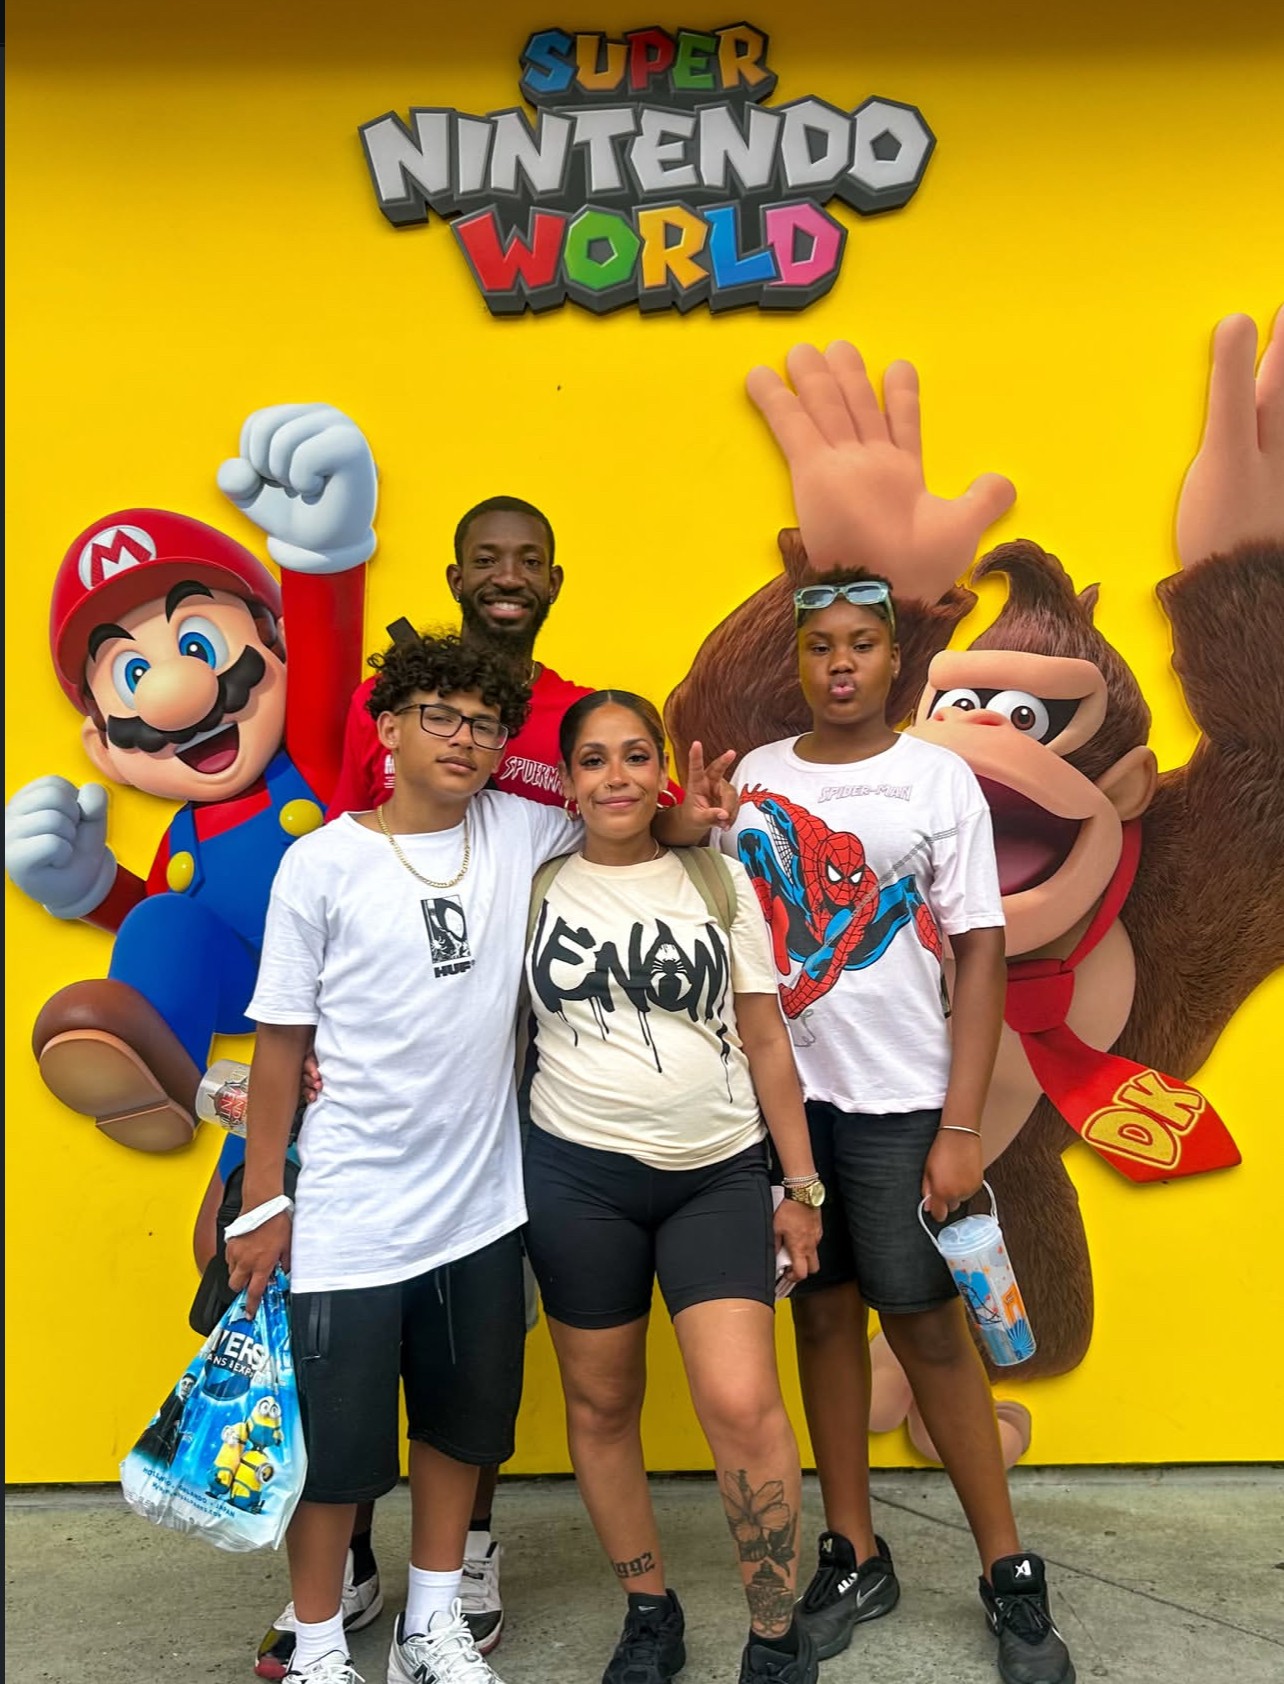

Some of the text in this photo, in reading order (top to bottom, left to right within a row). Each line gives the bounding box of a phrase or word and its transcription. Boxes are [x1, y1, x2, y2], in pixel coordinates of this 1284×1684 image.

[524, 24, 770, 92] SUPER
[361, 97, 934, 202] NINTENDO
[456, 202, 844, 292] WORLD
[91, 528, 153, 588] M
[817, 784, 914, 804] SPIDER-MAN
[433, 960, 474, 979] HUF
[1081, 1069, 1206, 1170] DK
